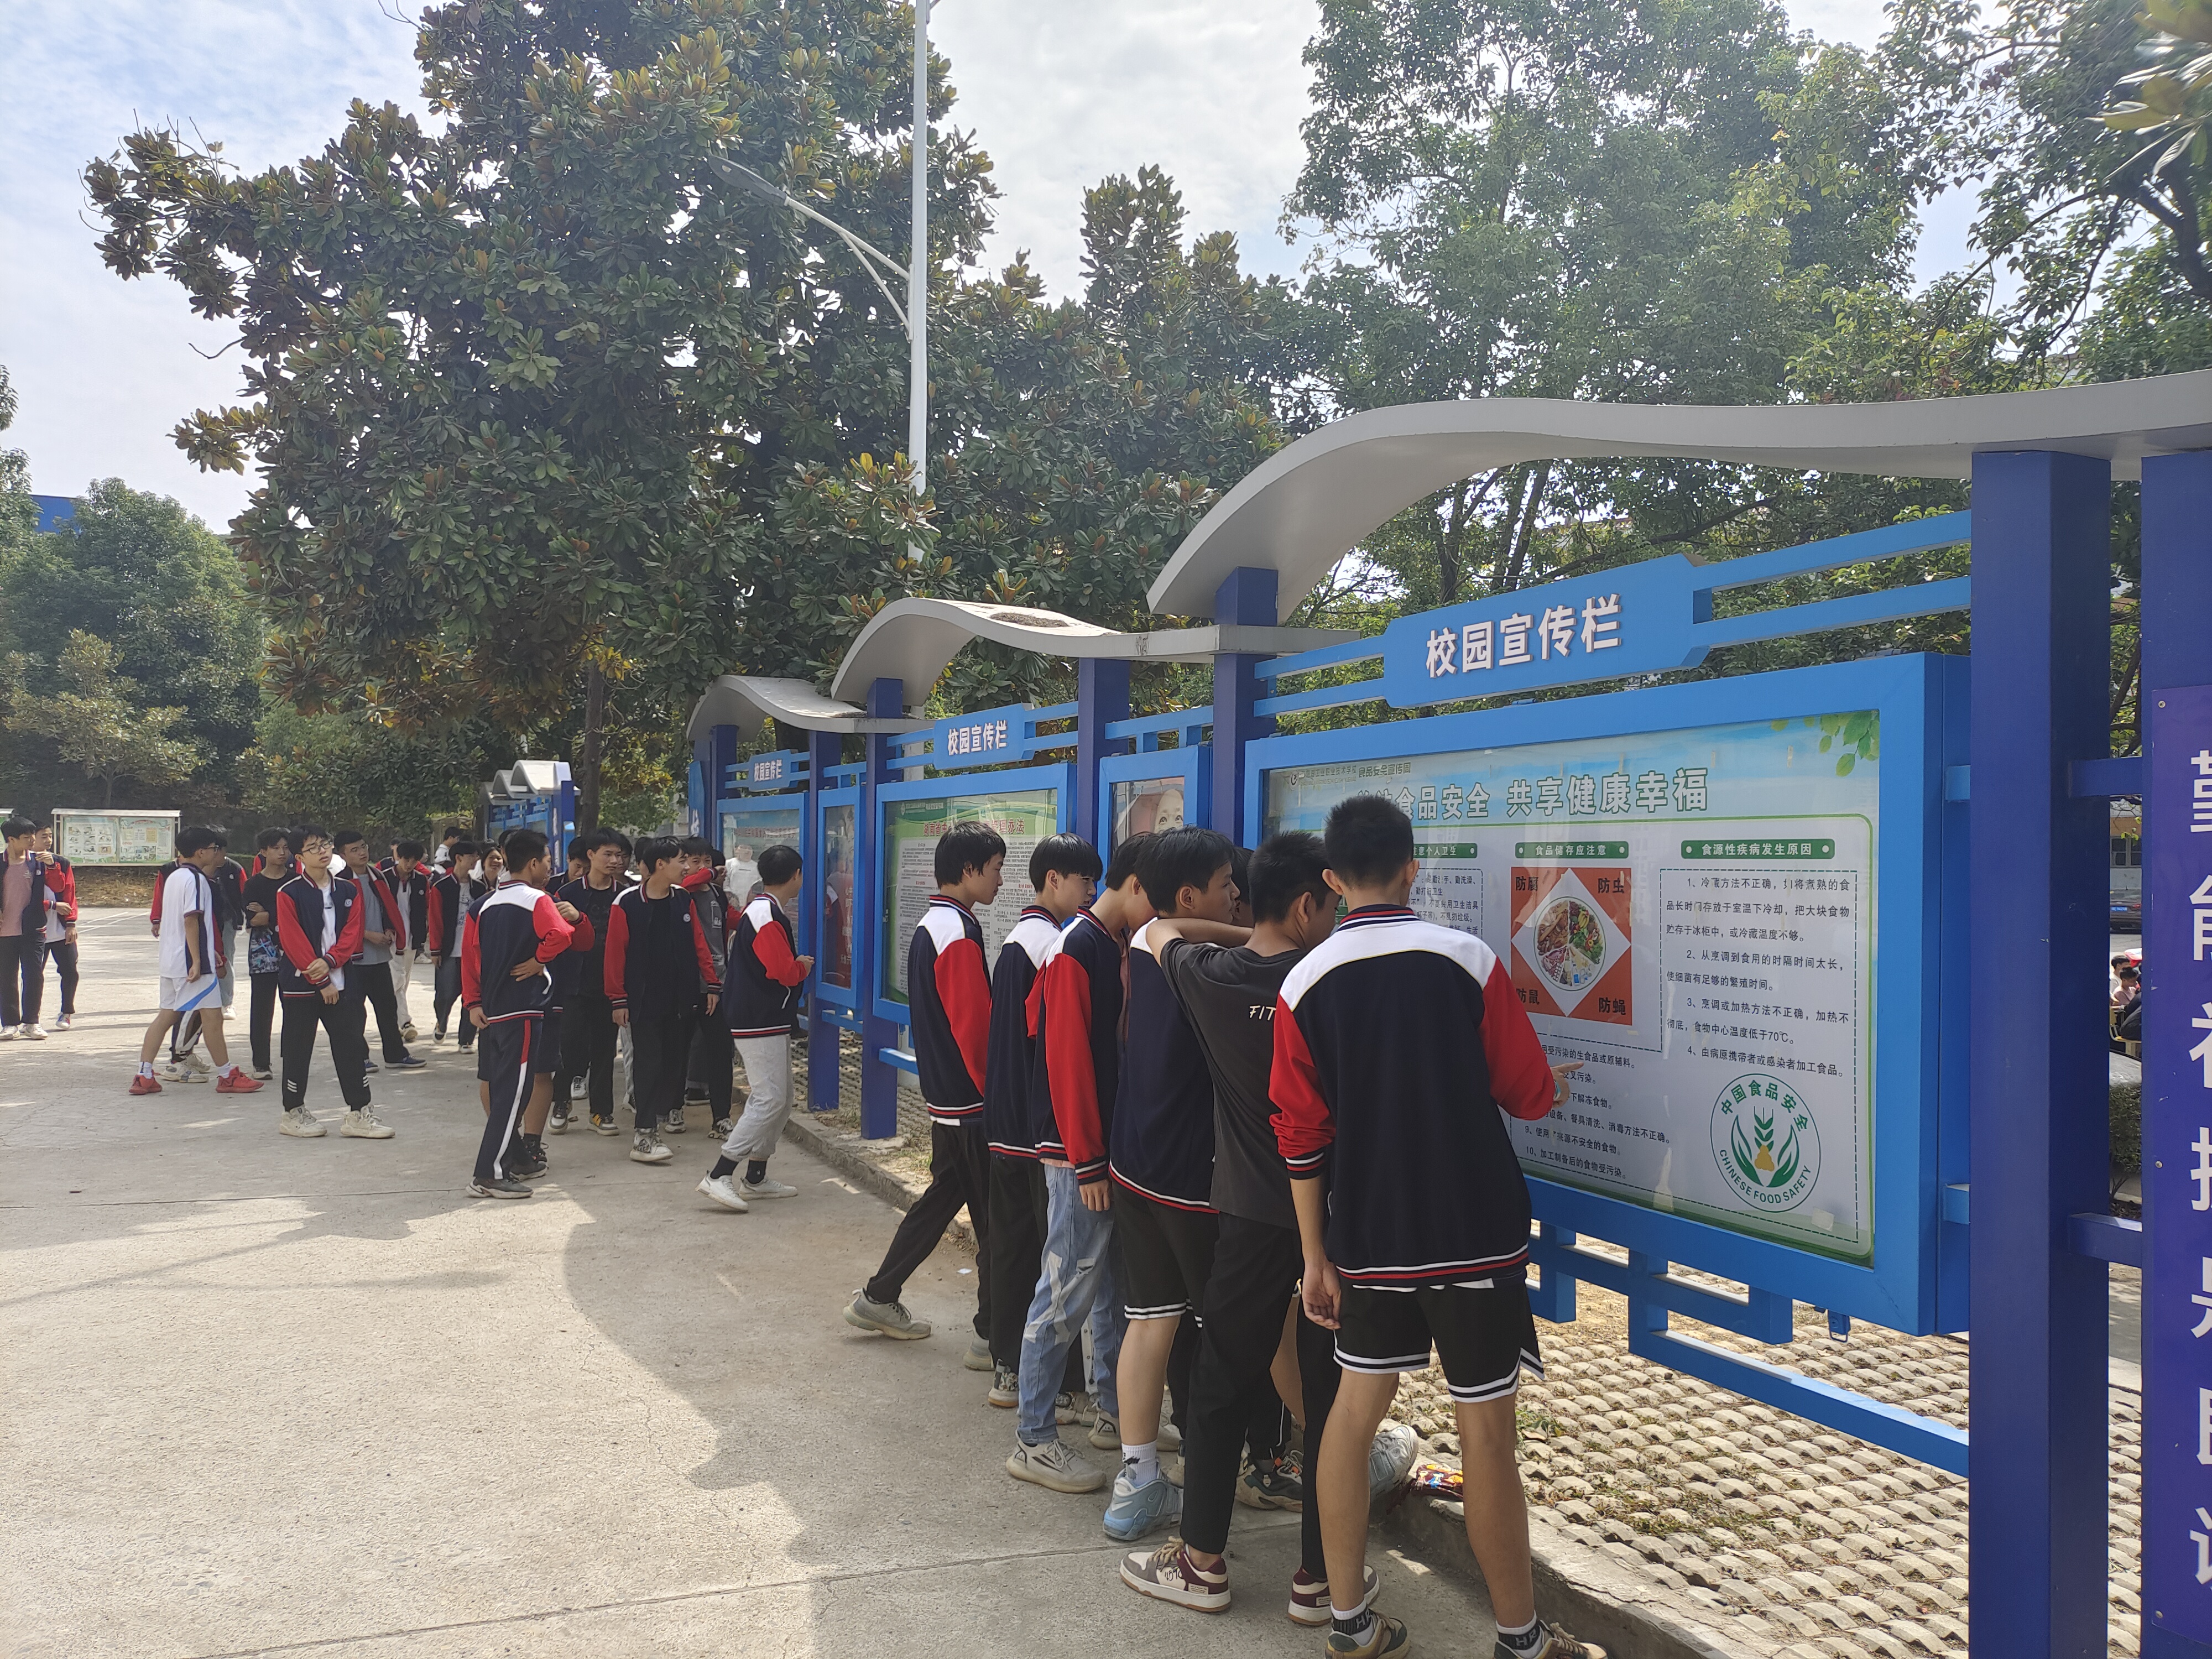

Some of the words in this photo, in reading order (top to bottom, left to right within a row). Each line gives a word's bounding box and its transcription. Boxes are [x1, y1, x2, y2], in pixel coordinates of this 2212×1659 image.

[1426, 593, 1622, 679] 校园宣传栏
[948, 719, 1008, 755] 校园宣传栏
[754, 759, 782, 782] 校园宣传栏
[1357, 782, 1490, 821] 食品安全
[1506, 768, 1708, 817] 共享健康幸福
[1535, 844, 1606, 856] 食品储存应注意
[1701, 843, 1812, 857] 食源性疾病发生原因
[1598, 878, 1625, 894] 防虫
[1666, 971, 1773, 991] 使细菌有足够的繁殖时间。
[1599, 997, 1626, 1015] 防蝇
[1687, 998, 1849, 1023] 3、烹调或加热方法不正确，加热不
[1687, 1046, 1843, 1077] 4、由病原携带者或感染者加工食品。
[1721, 1080, 1808, 1131] 中国食品安全
[1526, 1146, 1626, 1179] 10、加工制备后的食物受污染。
[1719, 1149, 1752, 1196] CHINESE
[1754, 1191, 1781, 1203] FOOD
[1782, 1165, 1811, 1201] SAFETY
